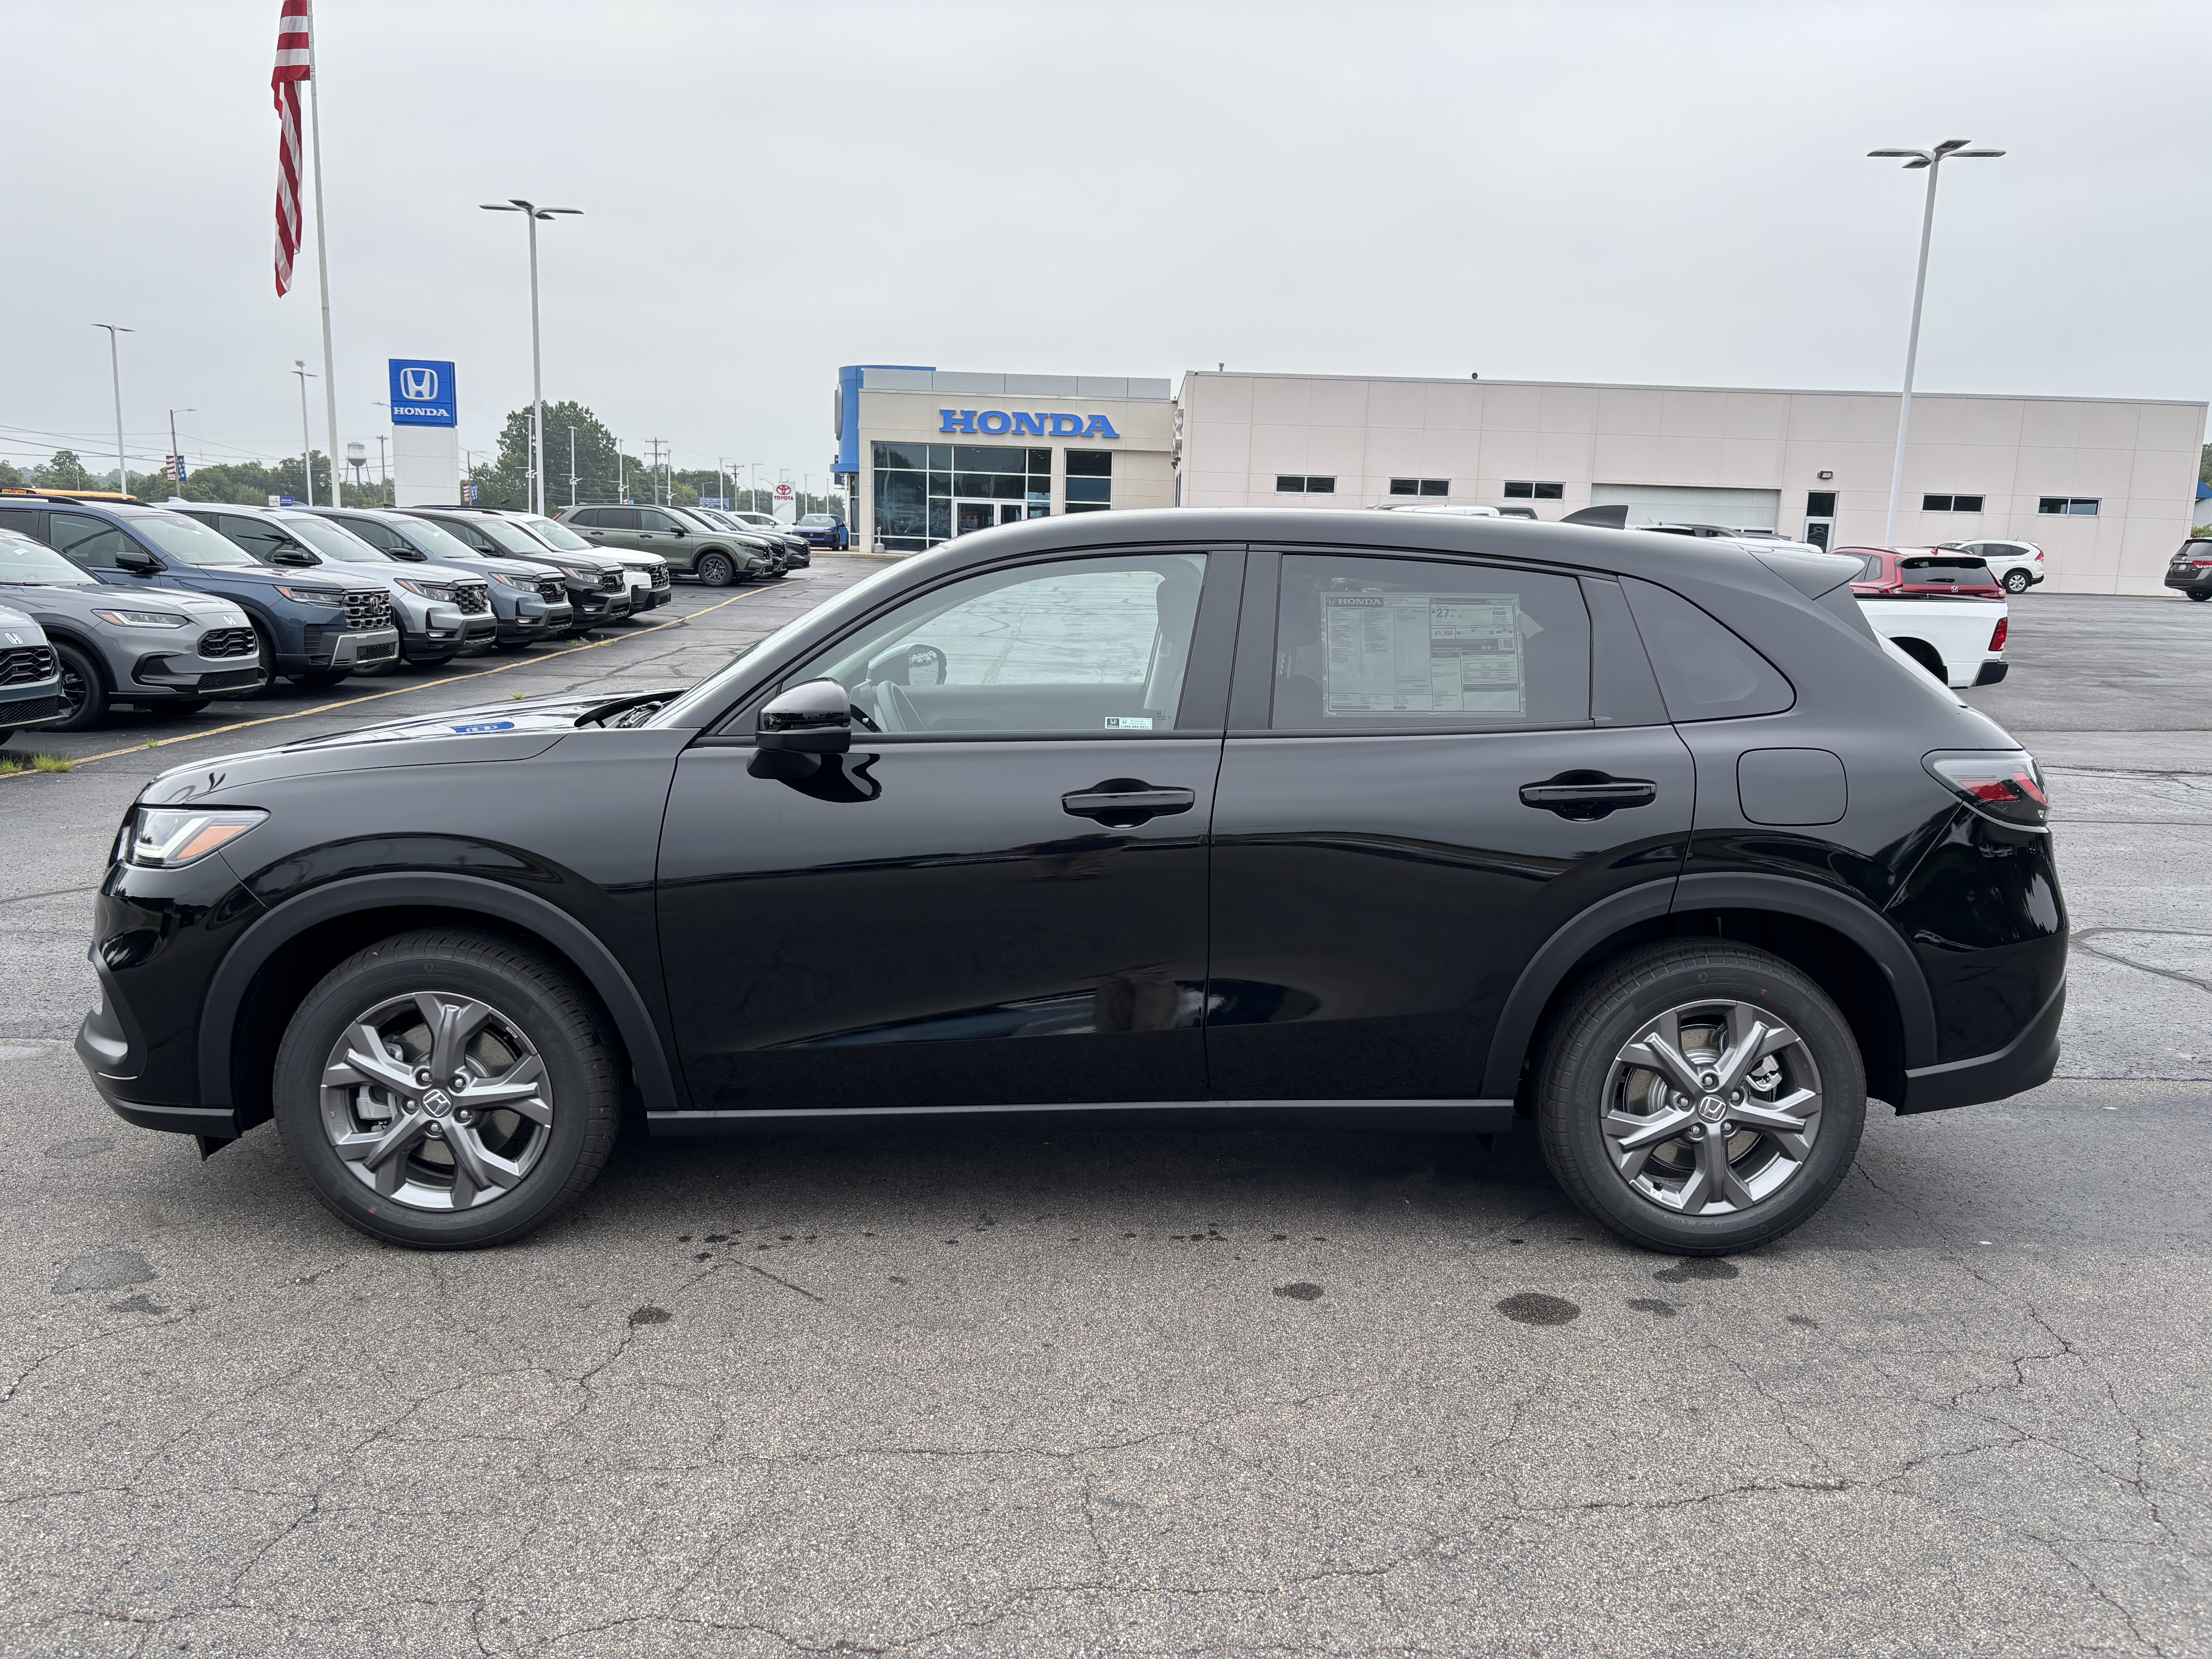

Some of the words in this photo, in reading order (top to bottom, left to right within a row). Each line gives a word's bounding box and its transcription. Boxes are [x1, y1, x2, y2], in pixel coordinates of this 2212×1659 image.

[393, 407, 450, 417] HONDA
[939, 410, 1120, 438] HONDA
[1437, 608, 1449, 617] 27
[1578, 1049, 1600, 1094] PRIMACY
[1606, 1010, 1629, 1034] SEASON
[1821, 1032, 1850, 1110] MICHELIN
[1577, 1108, 1607, 1187] MICHELIN
